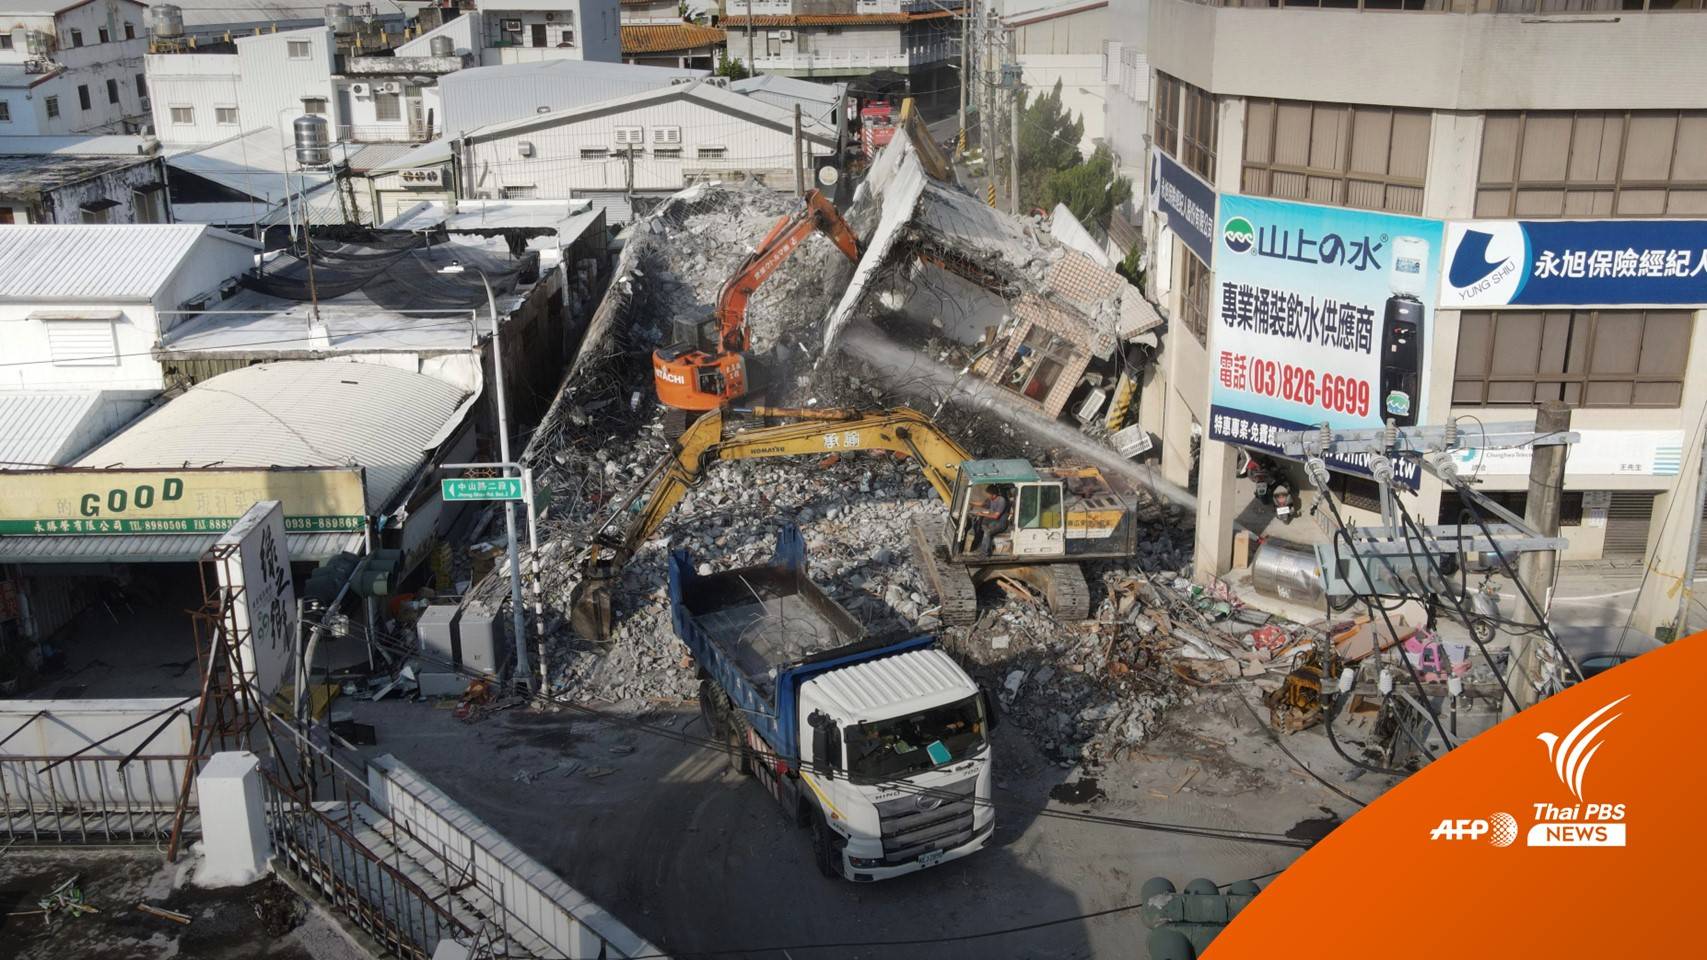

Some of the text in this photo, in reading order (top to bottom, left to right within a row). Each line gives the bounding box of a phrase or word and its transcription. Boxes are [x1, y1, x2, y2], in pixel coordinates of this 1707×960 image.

[1258, 225, 1382, 272] 山上の水
[1458, 260, 1516, 301] YUNG SHIU
[1221, 281, 1375, 355] 專業桶裝飲水供應商
[751, 446, 785, 455] KOMATSU
[80, 477, 184, 517] GOOD
